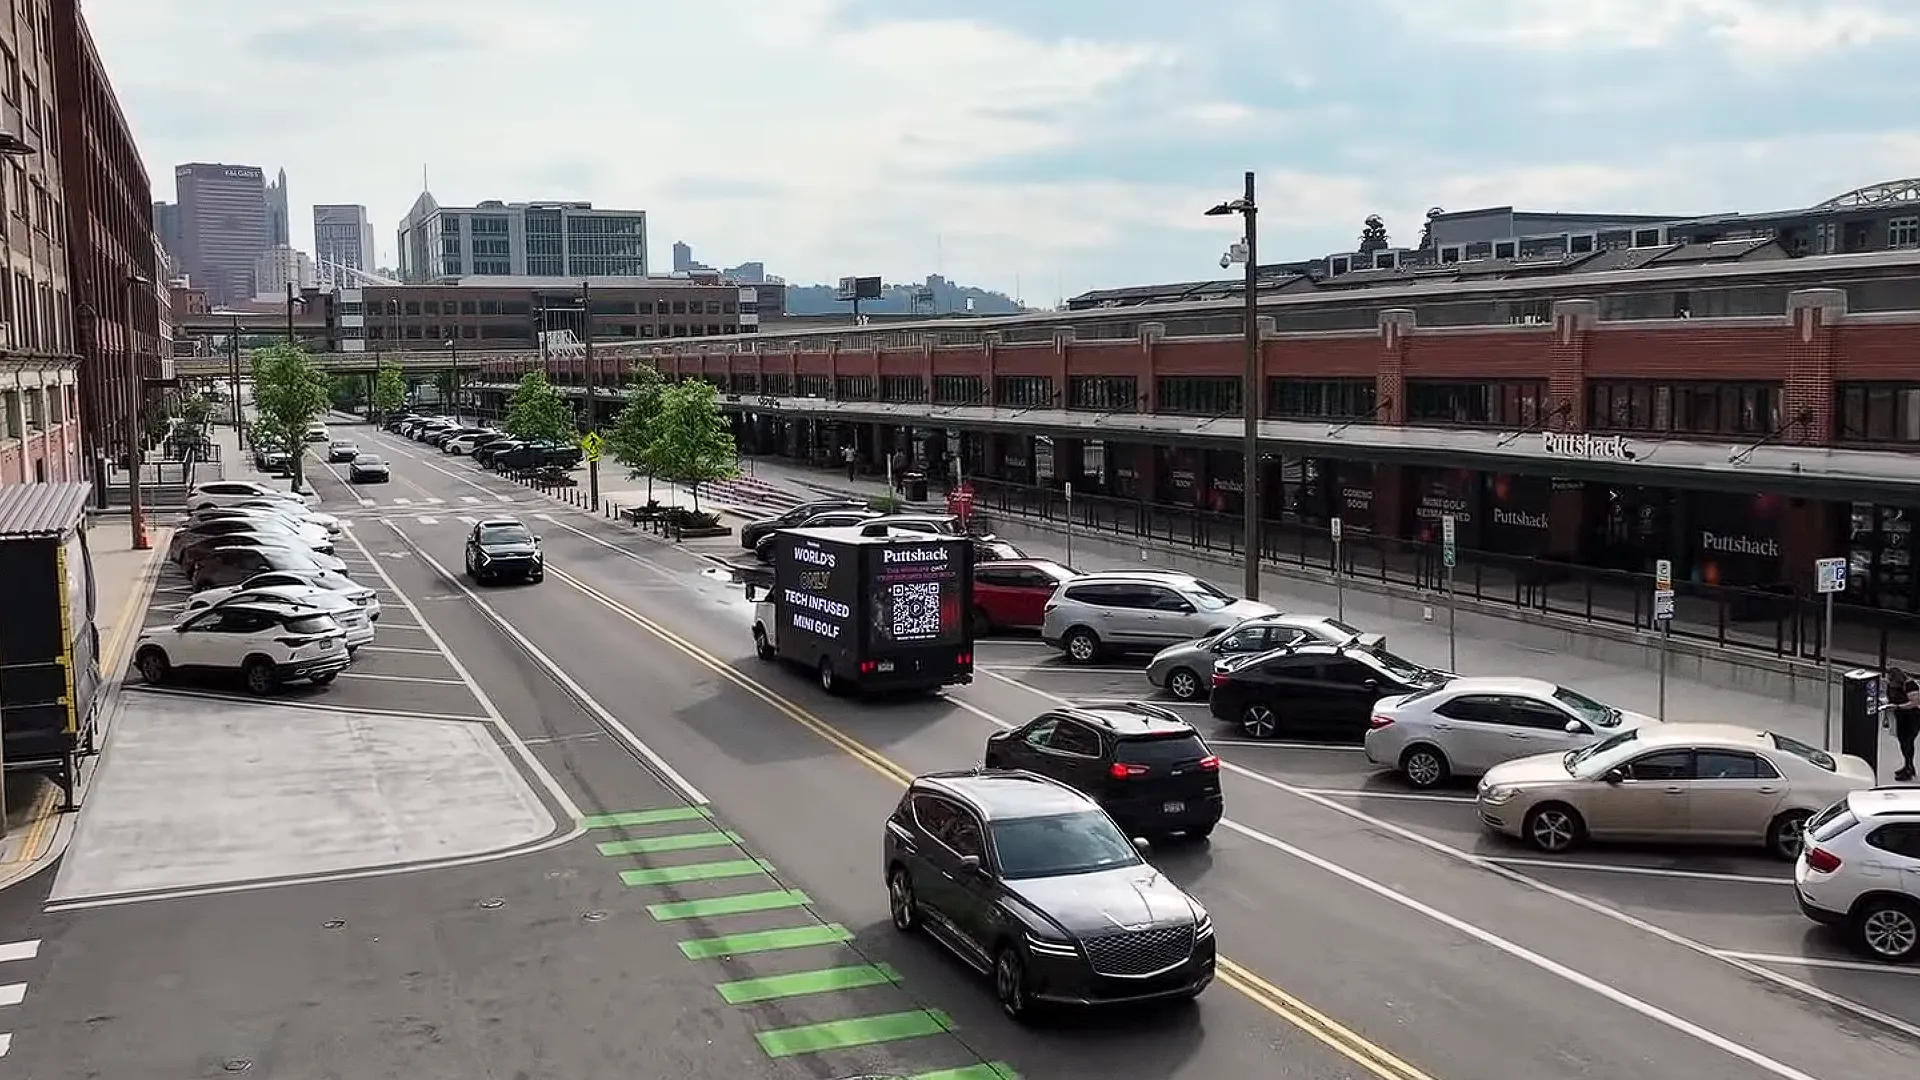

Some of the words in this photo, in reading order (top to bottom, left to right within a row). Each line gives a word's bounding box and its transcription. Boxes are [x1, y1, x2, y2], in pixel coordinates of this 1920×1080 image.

[1542, 432, 1631, 460] Puttshack
[1342, 488, 1373, 499] COMING
[1347, 499, 1369, 510] SOON
[1494, 508, 1549, 529] Puttshack
[1702, 531, 1779, 557] Puttshack
[794, 547, 836, 567] WORLD'S
[883, 547, 949, 563] Puttshack
[800, 571, 830, 589] ONLY
[785, 589, 808, 606] TECH
[808, 595, 850, 618] INFUSED
[793, 613, 815, 631] MINI
[815, 620, 840, 638] GOLF
